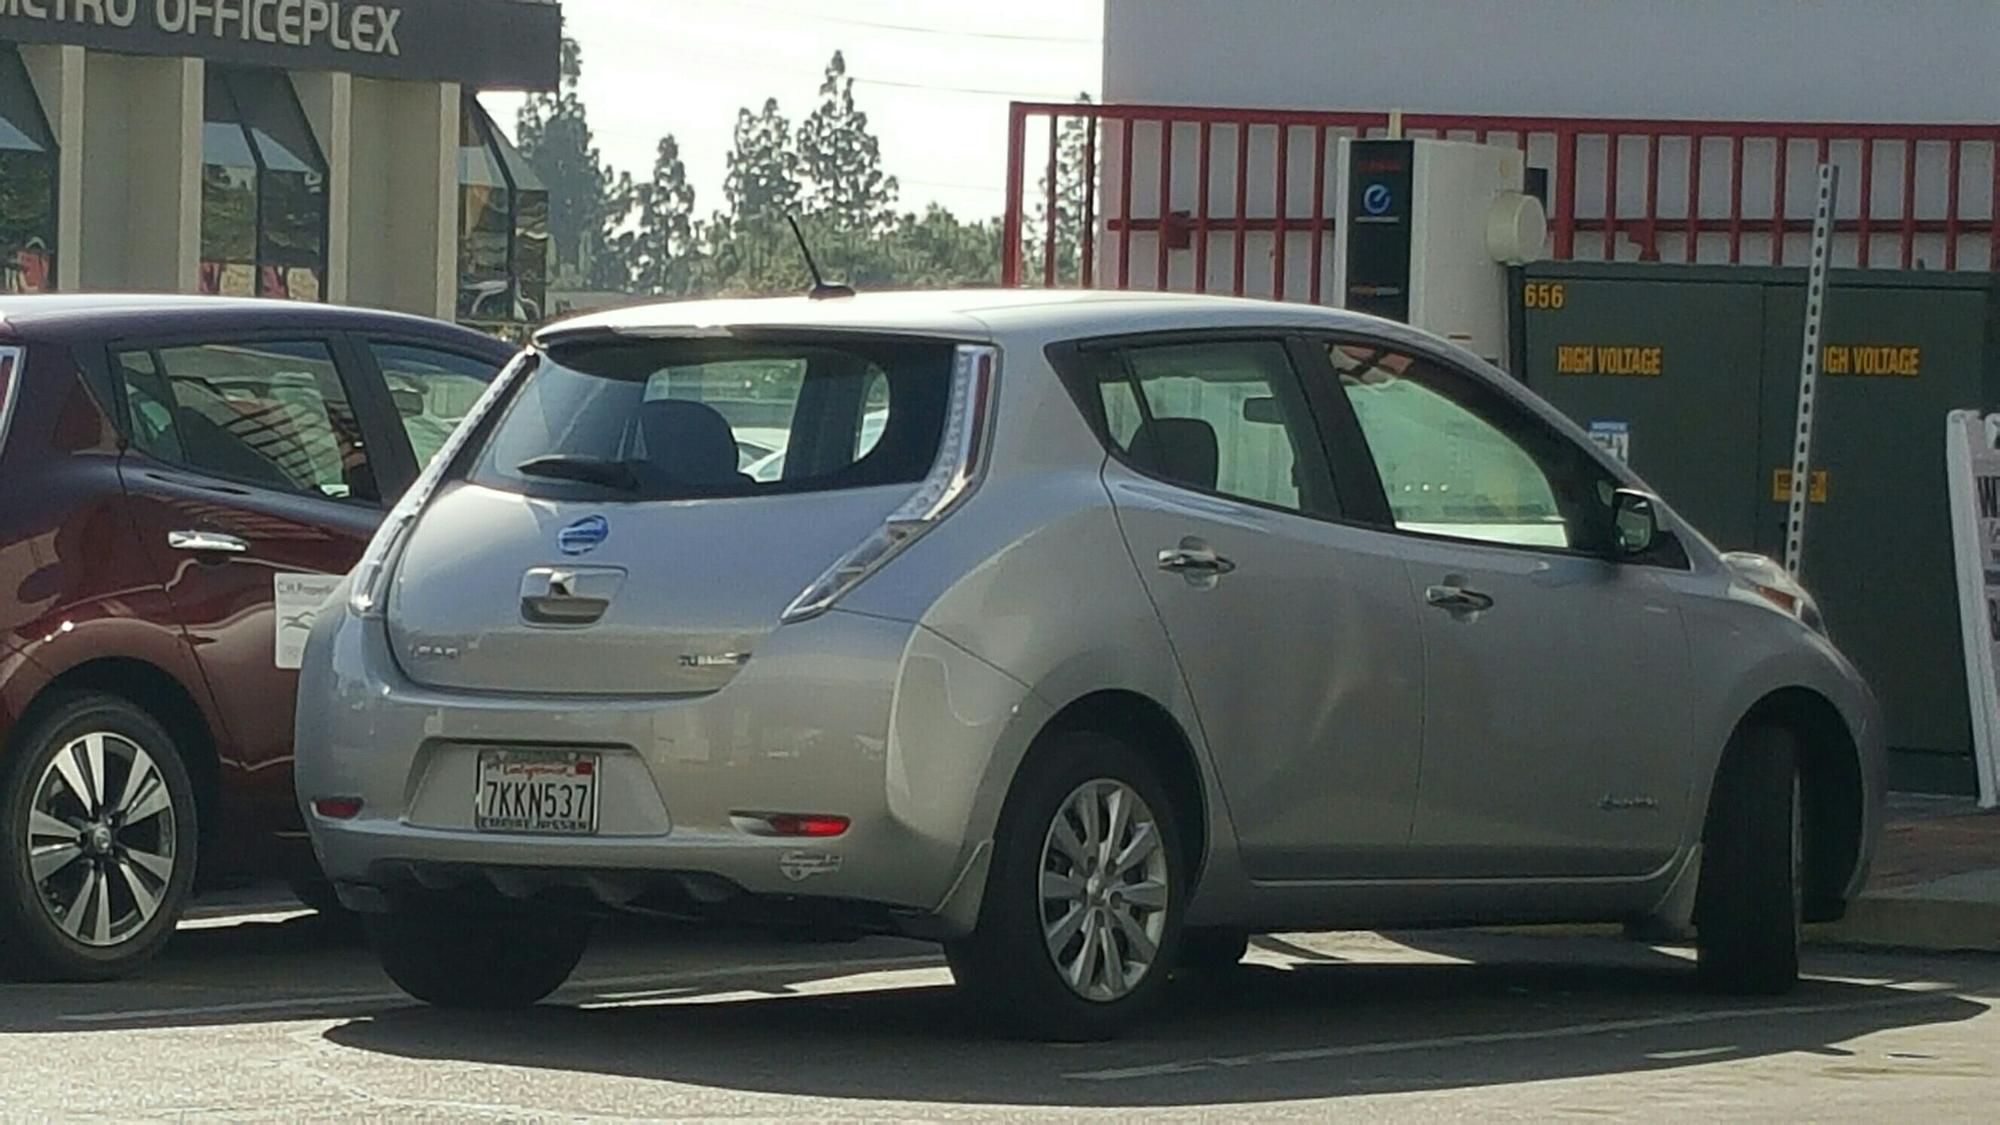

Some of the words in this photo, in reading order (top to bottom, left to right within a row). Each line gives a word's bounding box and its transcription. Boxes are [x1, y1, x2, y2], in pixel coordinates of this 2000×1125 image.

[156, 0, 400, 55] OFFICEPLEX
[1524, 283, 1564, 309] 656
[1557, 345, 1594, 373] HIGH
[1597, 346, 1662, 375] VOLTAGE
[1822, 345, 1850, 374] IGH
[1853, 346, 1920, 376] VOLTAGE
[486, 781, 588, 819] 7KKN537
